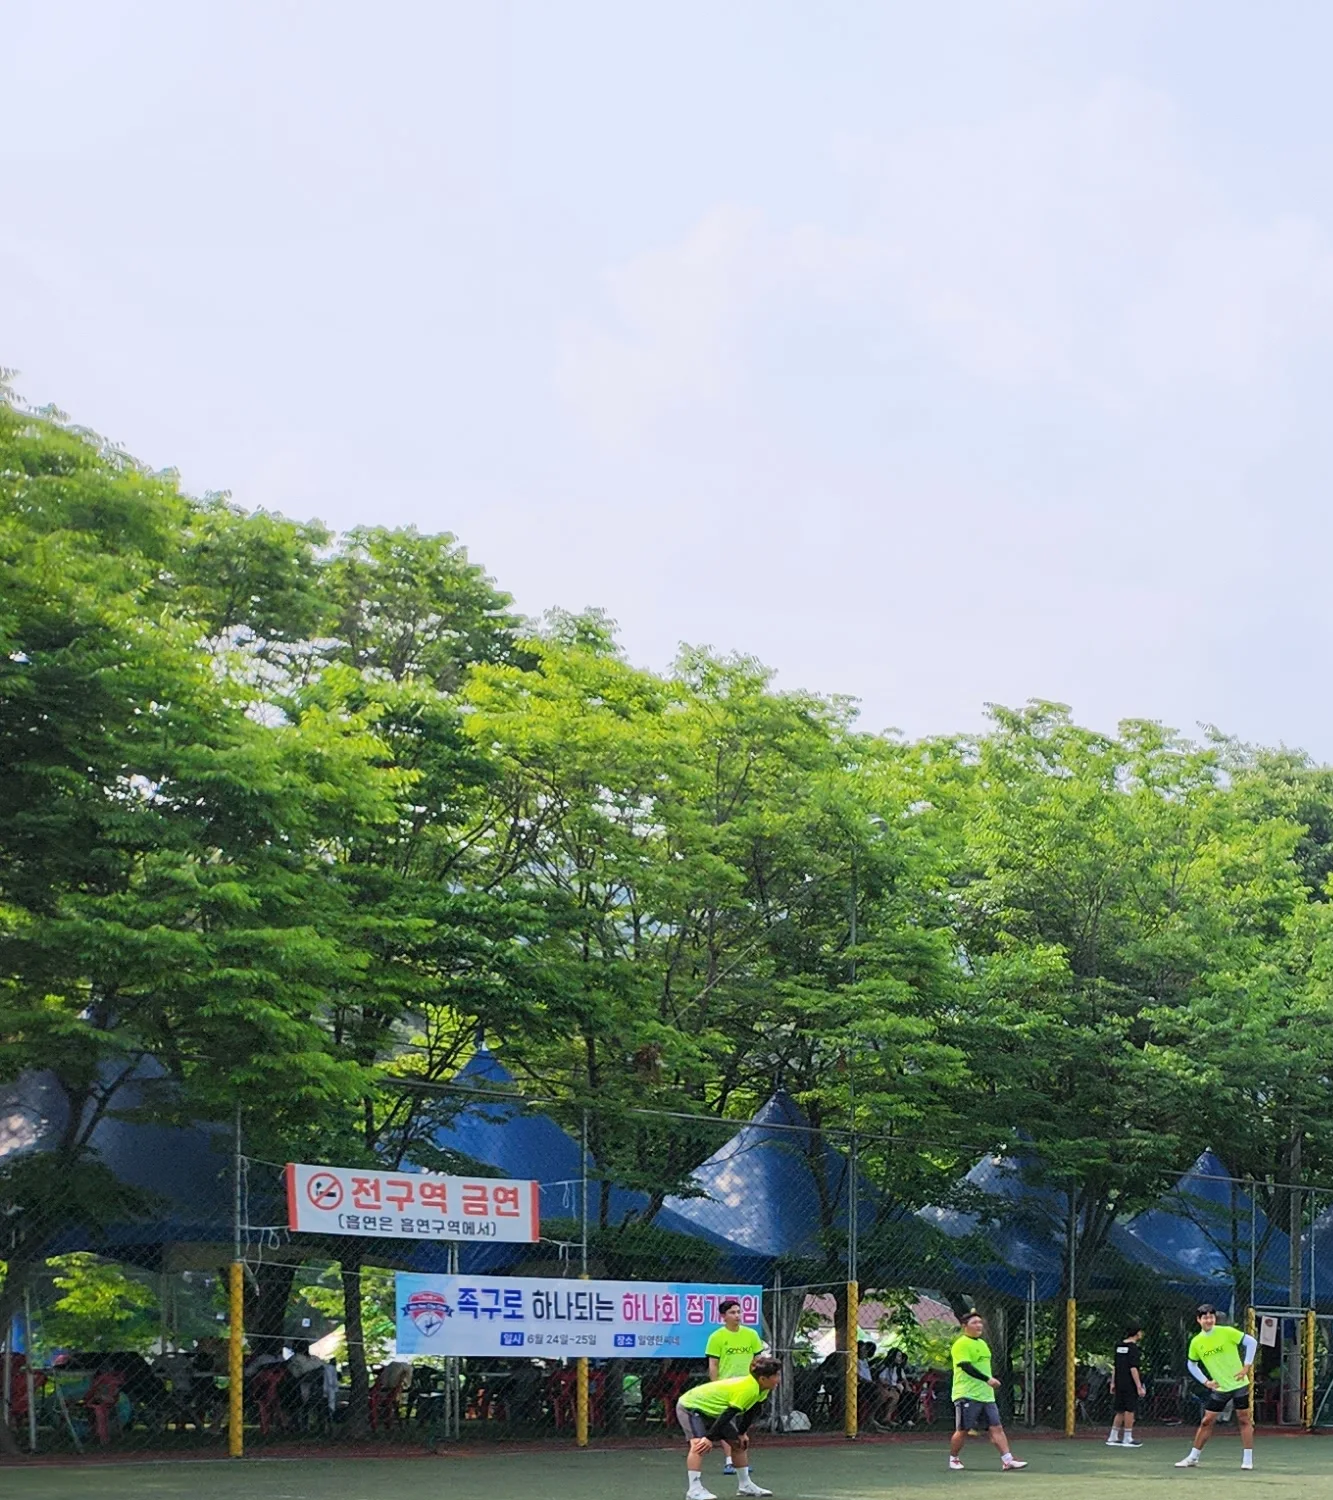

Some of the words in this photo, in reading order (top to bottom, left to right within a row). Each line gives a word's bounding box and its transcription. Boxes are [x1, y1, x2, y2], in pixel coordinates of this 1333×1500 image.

[351, 1177, 448, 1214] 전구역
[461, 1184, 521, 1218] 금연
[338, 1214, 393, 1232] (흡연은
[400, 1217, 497, 1237] 흡연구역에서)
[457, 1287, 525, 1320] 족구로
[532, 1290, 614, 1322] 하나되는
[622, 1292, 680, 1324] 하나회
[686, 1294, 758, 1324] 정기임
[503, 1333, 522, 1345] 일시
[527, 1334, 544, 1345] 6월
[546, 1334, 597, 1346] 24일~25일
[616, 1336, 634, 1347] 장소
